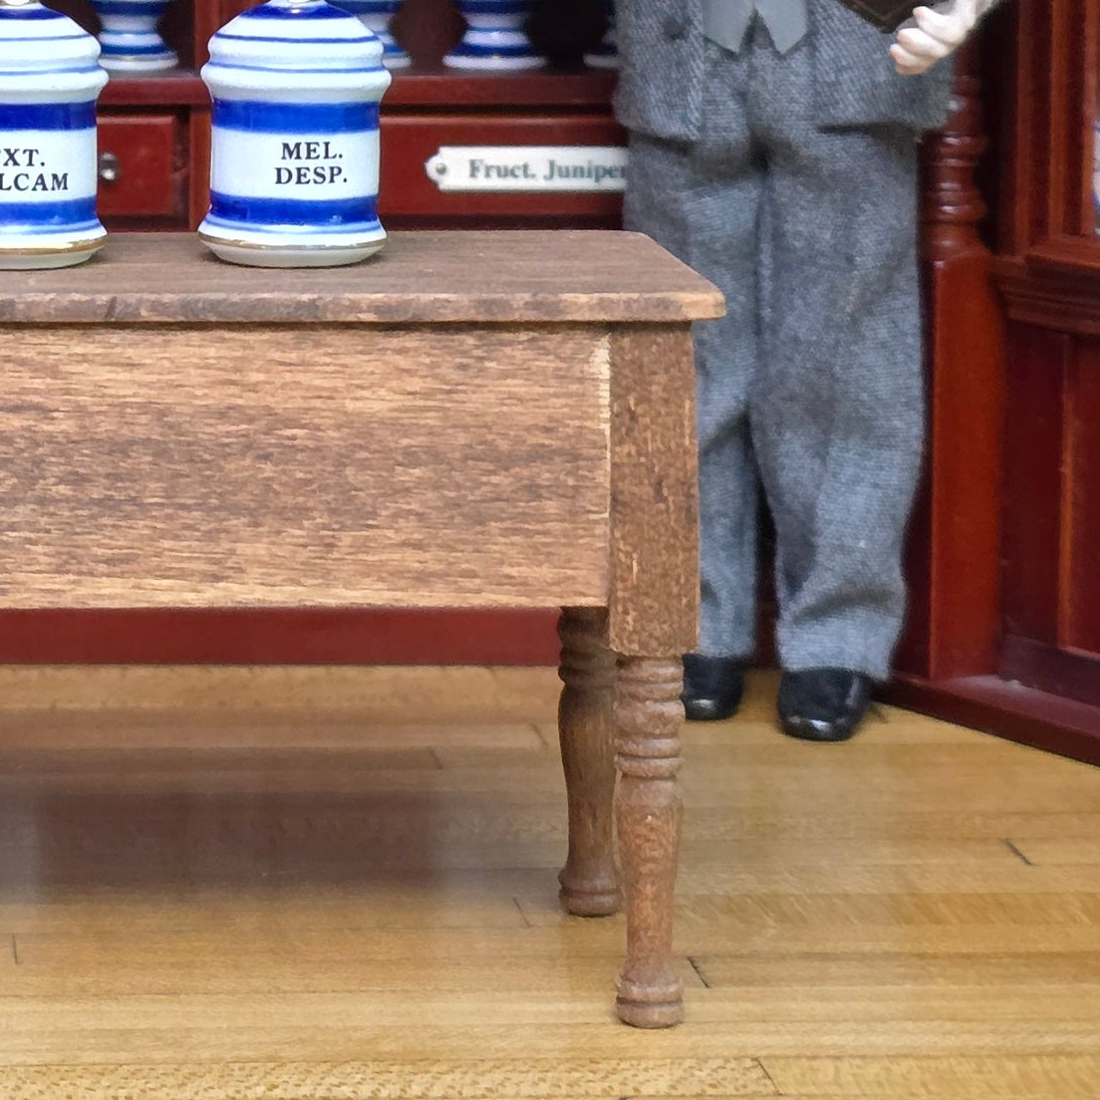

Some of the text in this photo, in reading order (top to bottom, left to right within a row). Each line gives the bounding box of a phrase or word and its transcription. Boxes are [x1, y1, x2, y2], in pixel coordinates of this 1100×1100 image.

[280, 141, 343, 161] MEL.
[274, 165, 348, 185] DESP.
[469, 159, 536, 180] Fruct.
